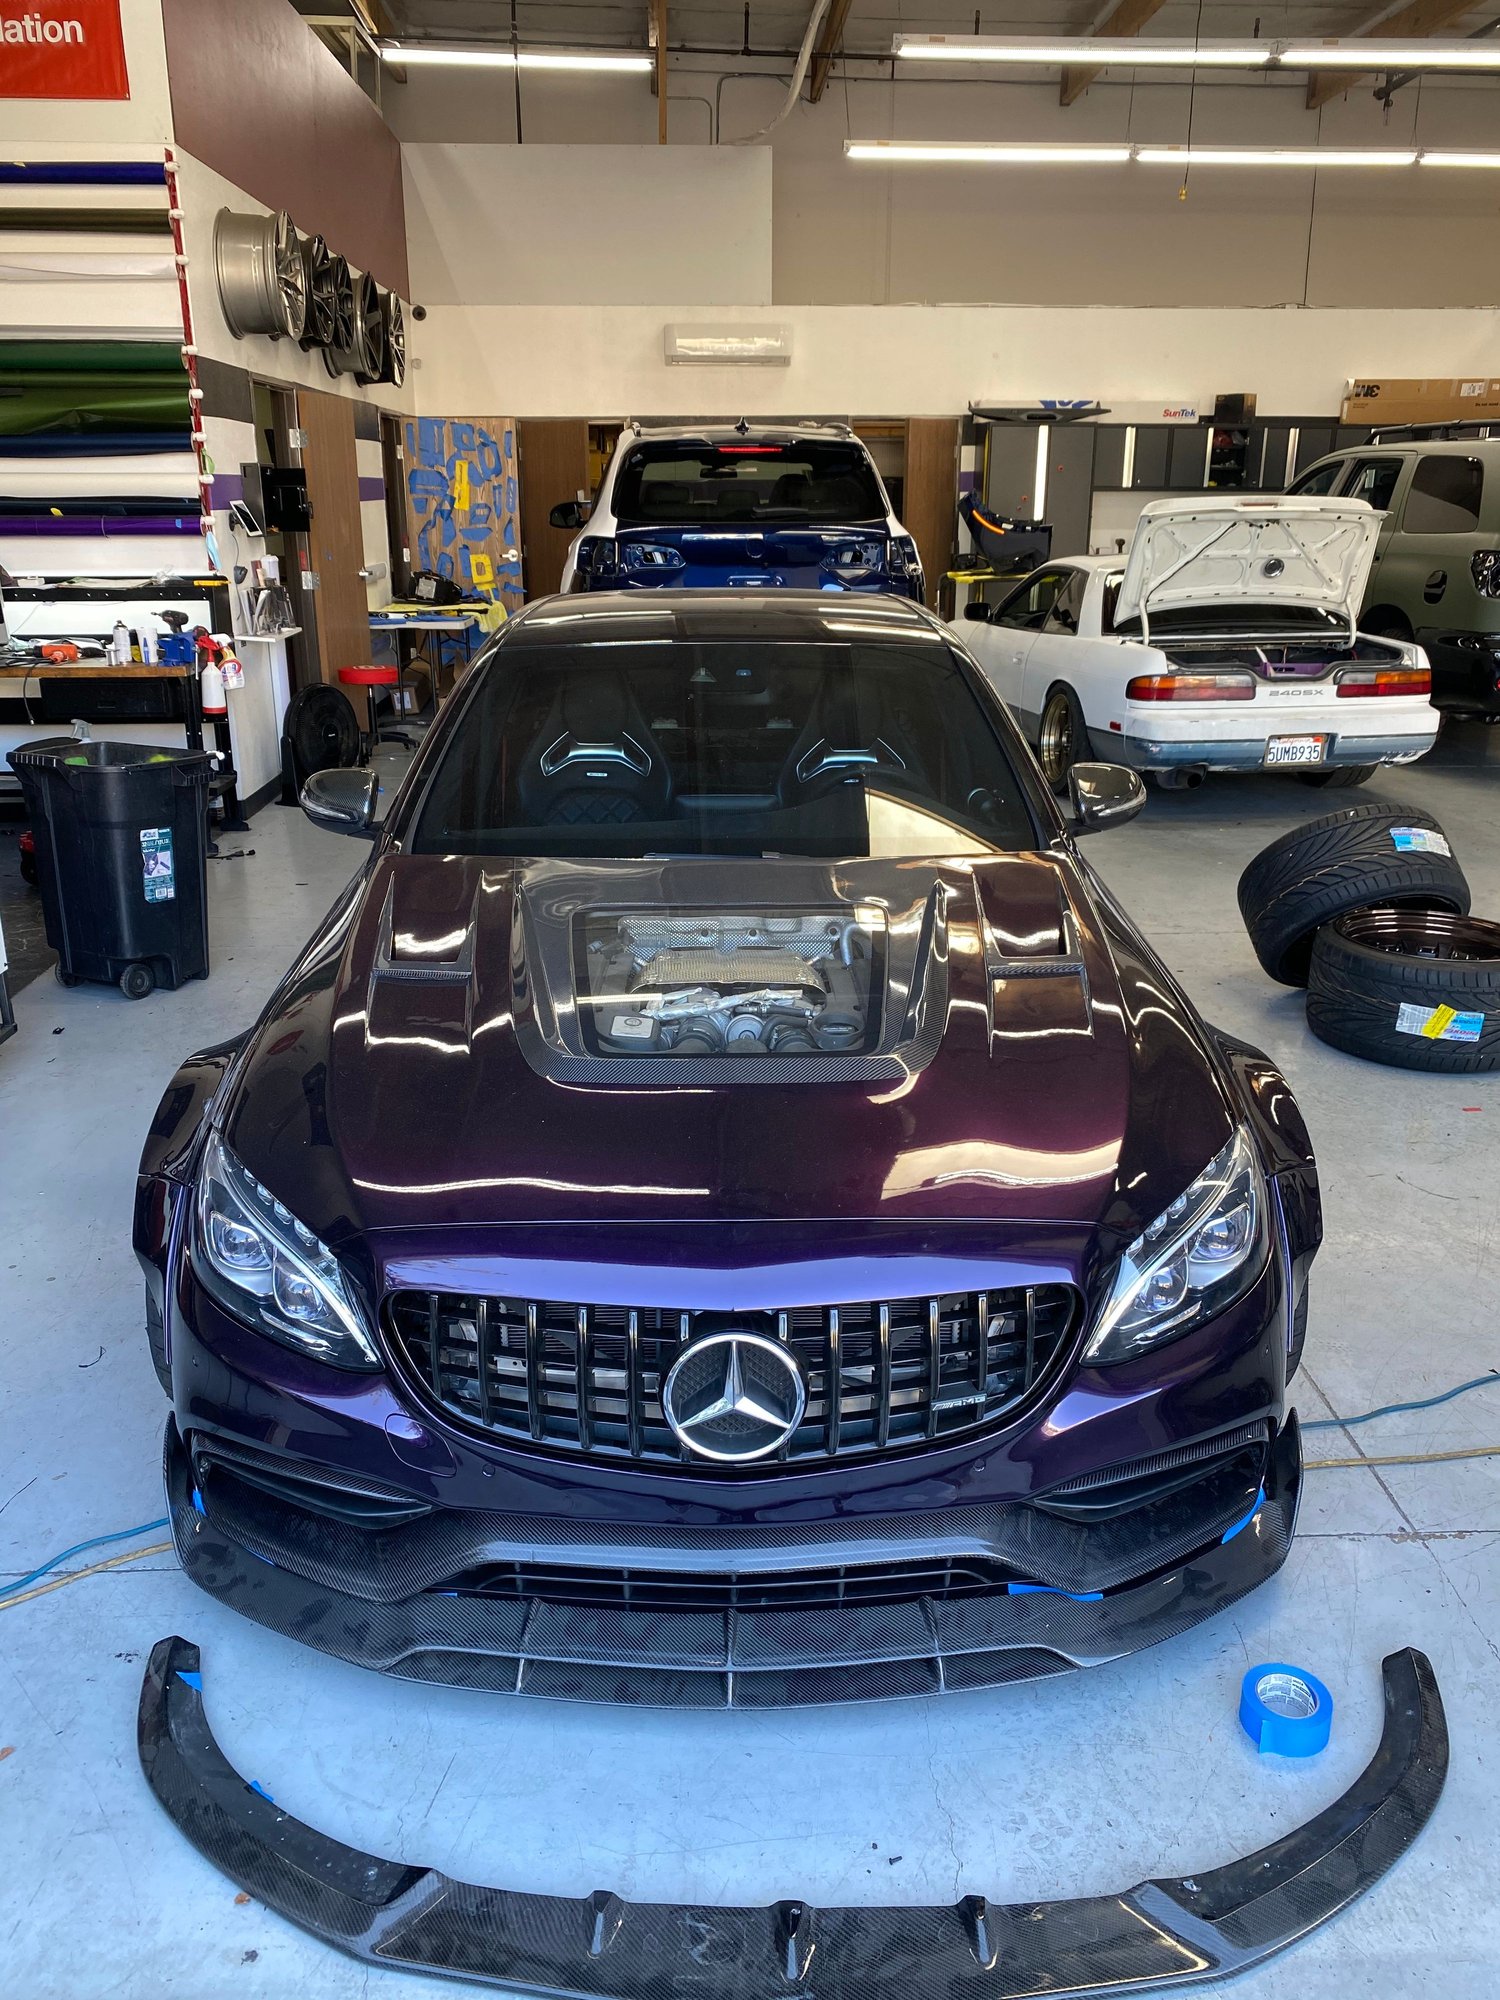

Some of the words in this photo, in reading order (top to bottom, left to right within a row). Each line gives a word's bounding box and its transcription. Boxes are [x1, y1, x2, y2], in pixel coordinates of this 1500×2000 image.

[1163, 408, 1196, 418] SunTek
[1269, 689, 1324, 697] 240SX
[1268, 745, 1320, 762] 5UMB935
